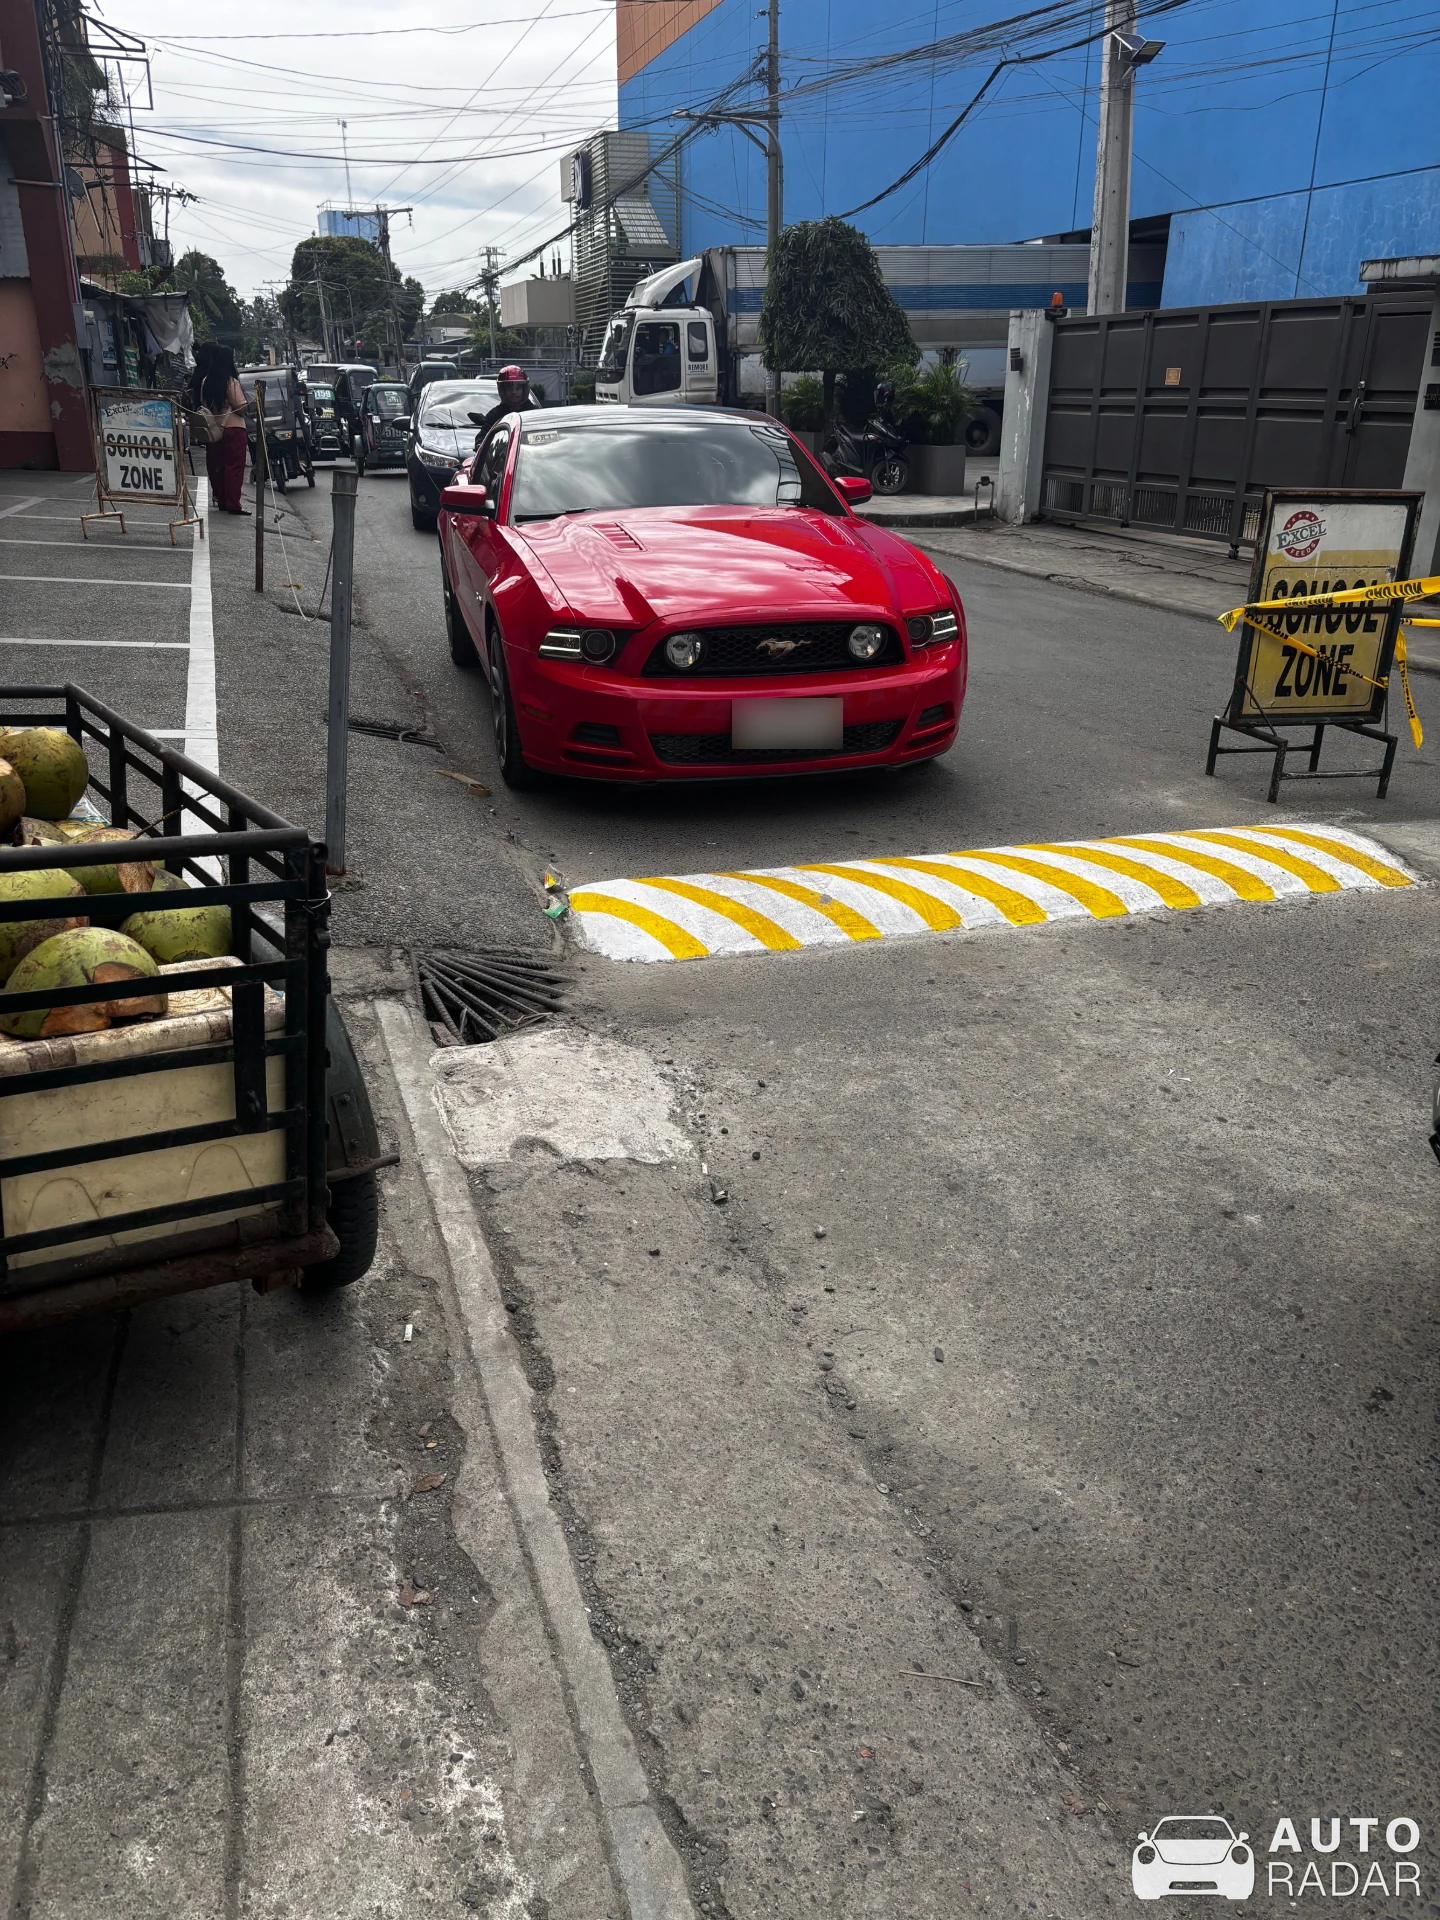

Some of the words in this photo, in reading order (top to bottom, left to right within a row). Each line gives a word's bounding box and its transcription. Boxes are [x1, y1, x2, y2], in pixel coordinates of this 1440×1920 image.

[104, 405, 133, 418] EXCEL
[106, 433, 173, 461] SCHOOL
[120, 465, 164, 491] ZONE
[1276, 523, 1327, 550] EXCEL
[1290, 543, 1316, 556] FEEDS
[1266, 579, 1379, 635] SCHOOL
[1274, 644, 1355, 698] ZONE
